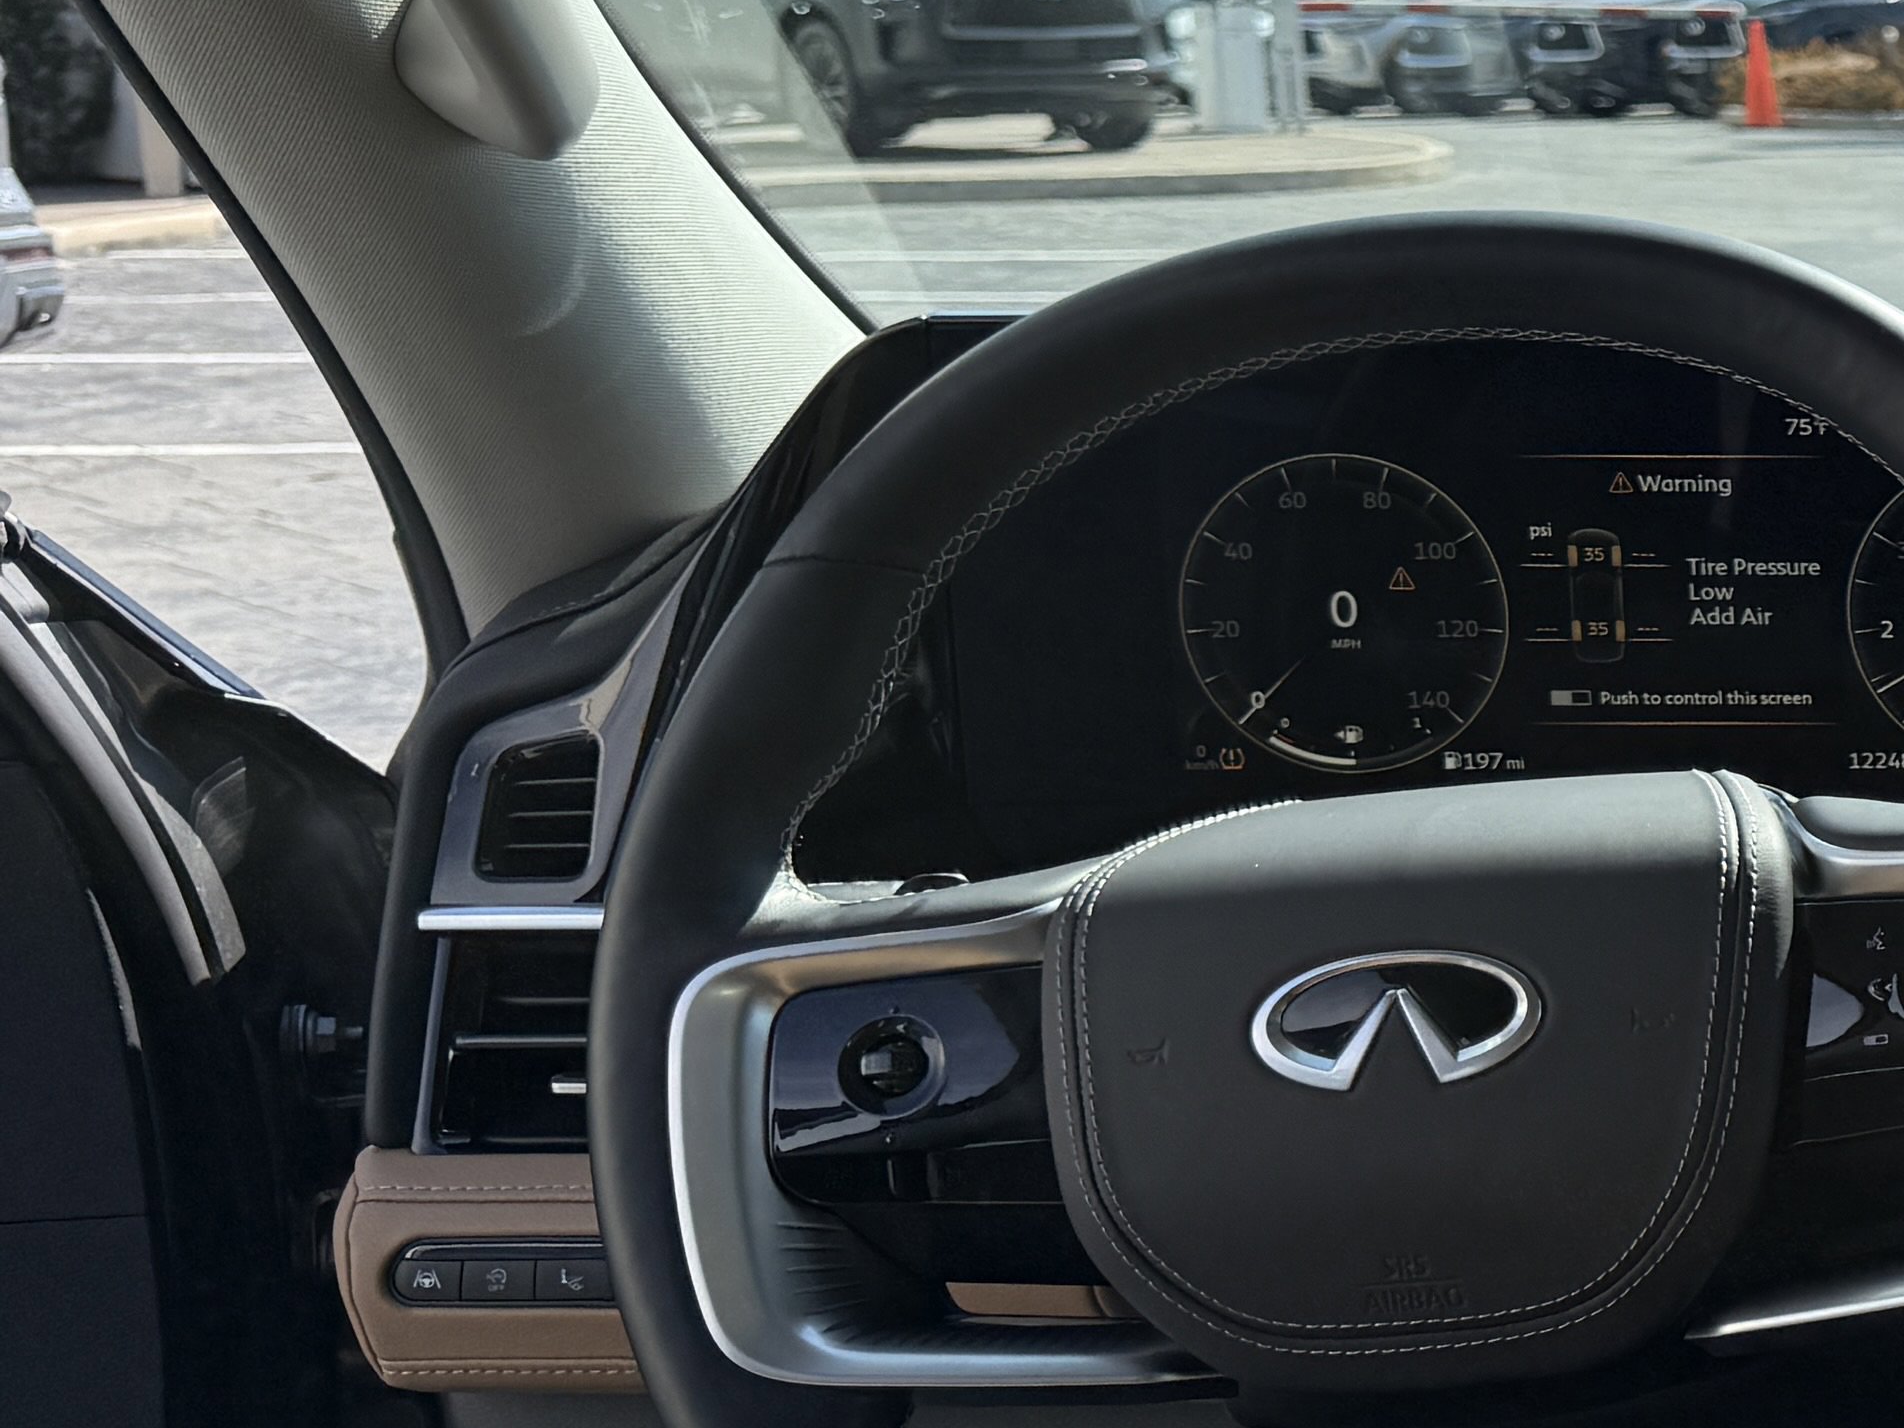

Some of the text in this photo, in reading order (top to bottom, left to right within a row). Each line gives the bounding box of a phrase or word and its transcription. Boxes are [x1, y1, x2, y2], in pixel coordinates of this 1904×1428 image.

[1637, 474, 1733, 497] Warning
[1279, 491, 1306, 509] 60
[1363, 491, 1391, 510] 80
[1529, 524, 1552, 540] psi
[1224, 542, 1253, 560] 40
[1414, 542, 1456, 560] 100
[1583, 547, 1605, 563] 35
[1686, 557, 1821, 576] Tire Pressure
[1689, 583, 1734, 601] Low
[1330, 590, 1358, 628] 0
[1690, 608, 1774, 626] Add Air
[1212, 621, 1240, 638] 20
[1437, 621, 1479, 638] 120
[1587, 623, 1609, 637] 35
[1880, 620, 1894, 638] 2
[1331, 639, 1362, 650] MPH
[1250, 691, 1265, 709] 0
[1408, 691, 1450, 709] 140
[1601, 690, 1812, 706] Push to control this screen
[1463, 752, 1525, 770] 197 mi
